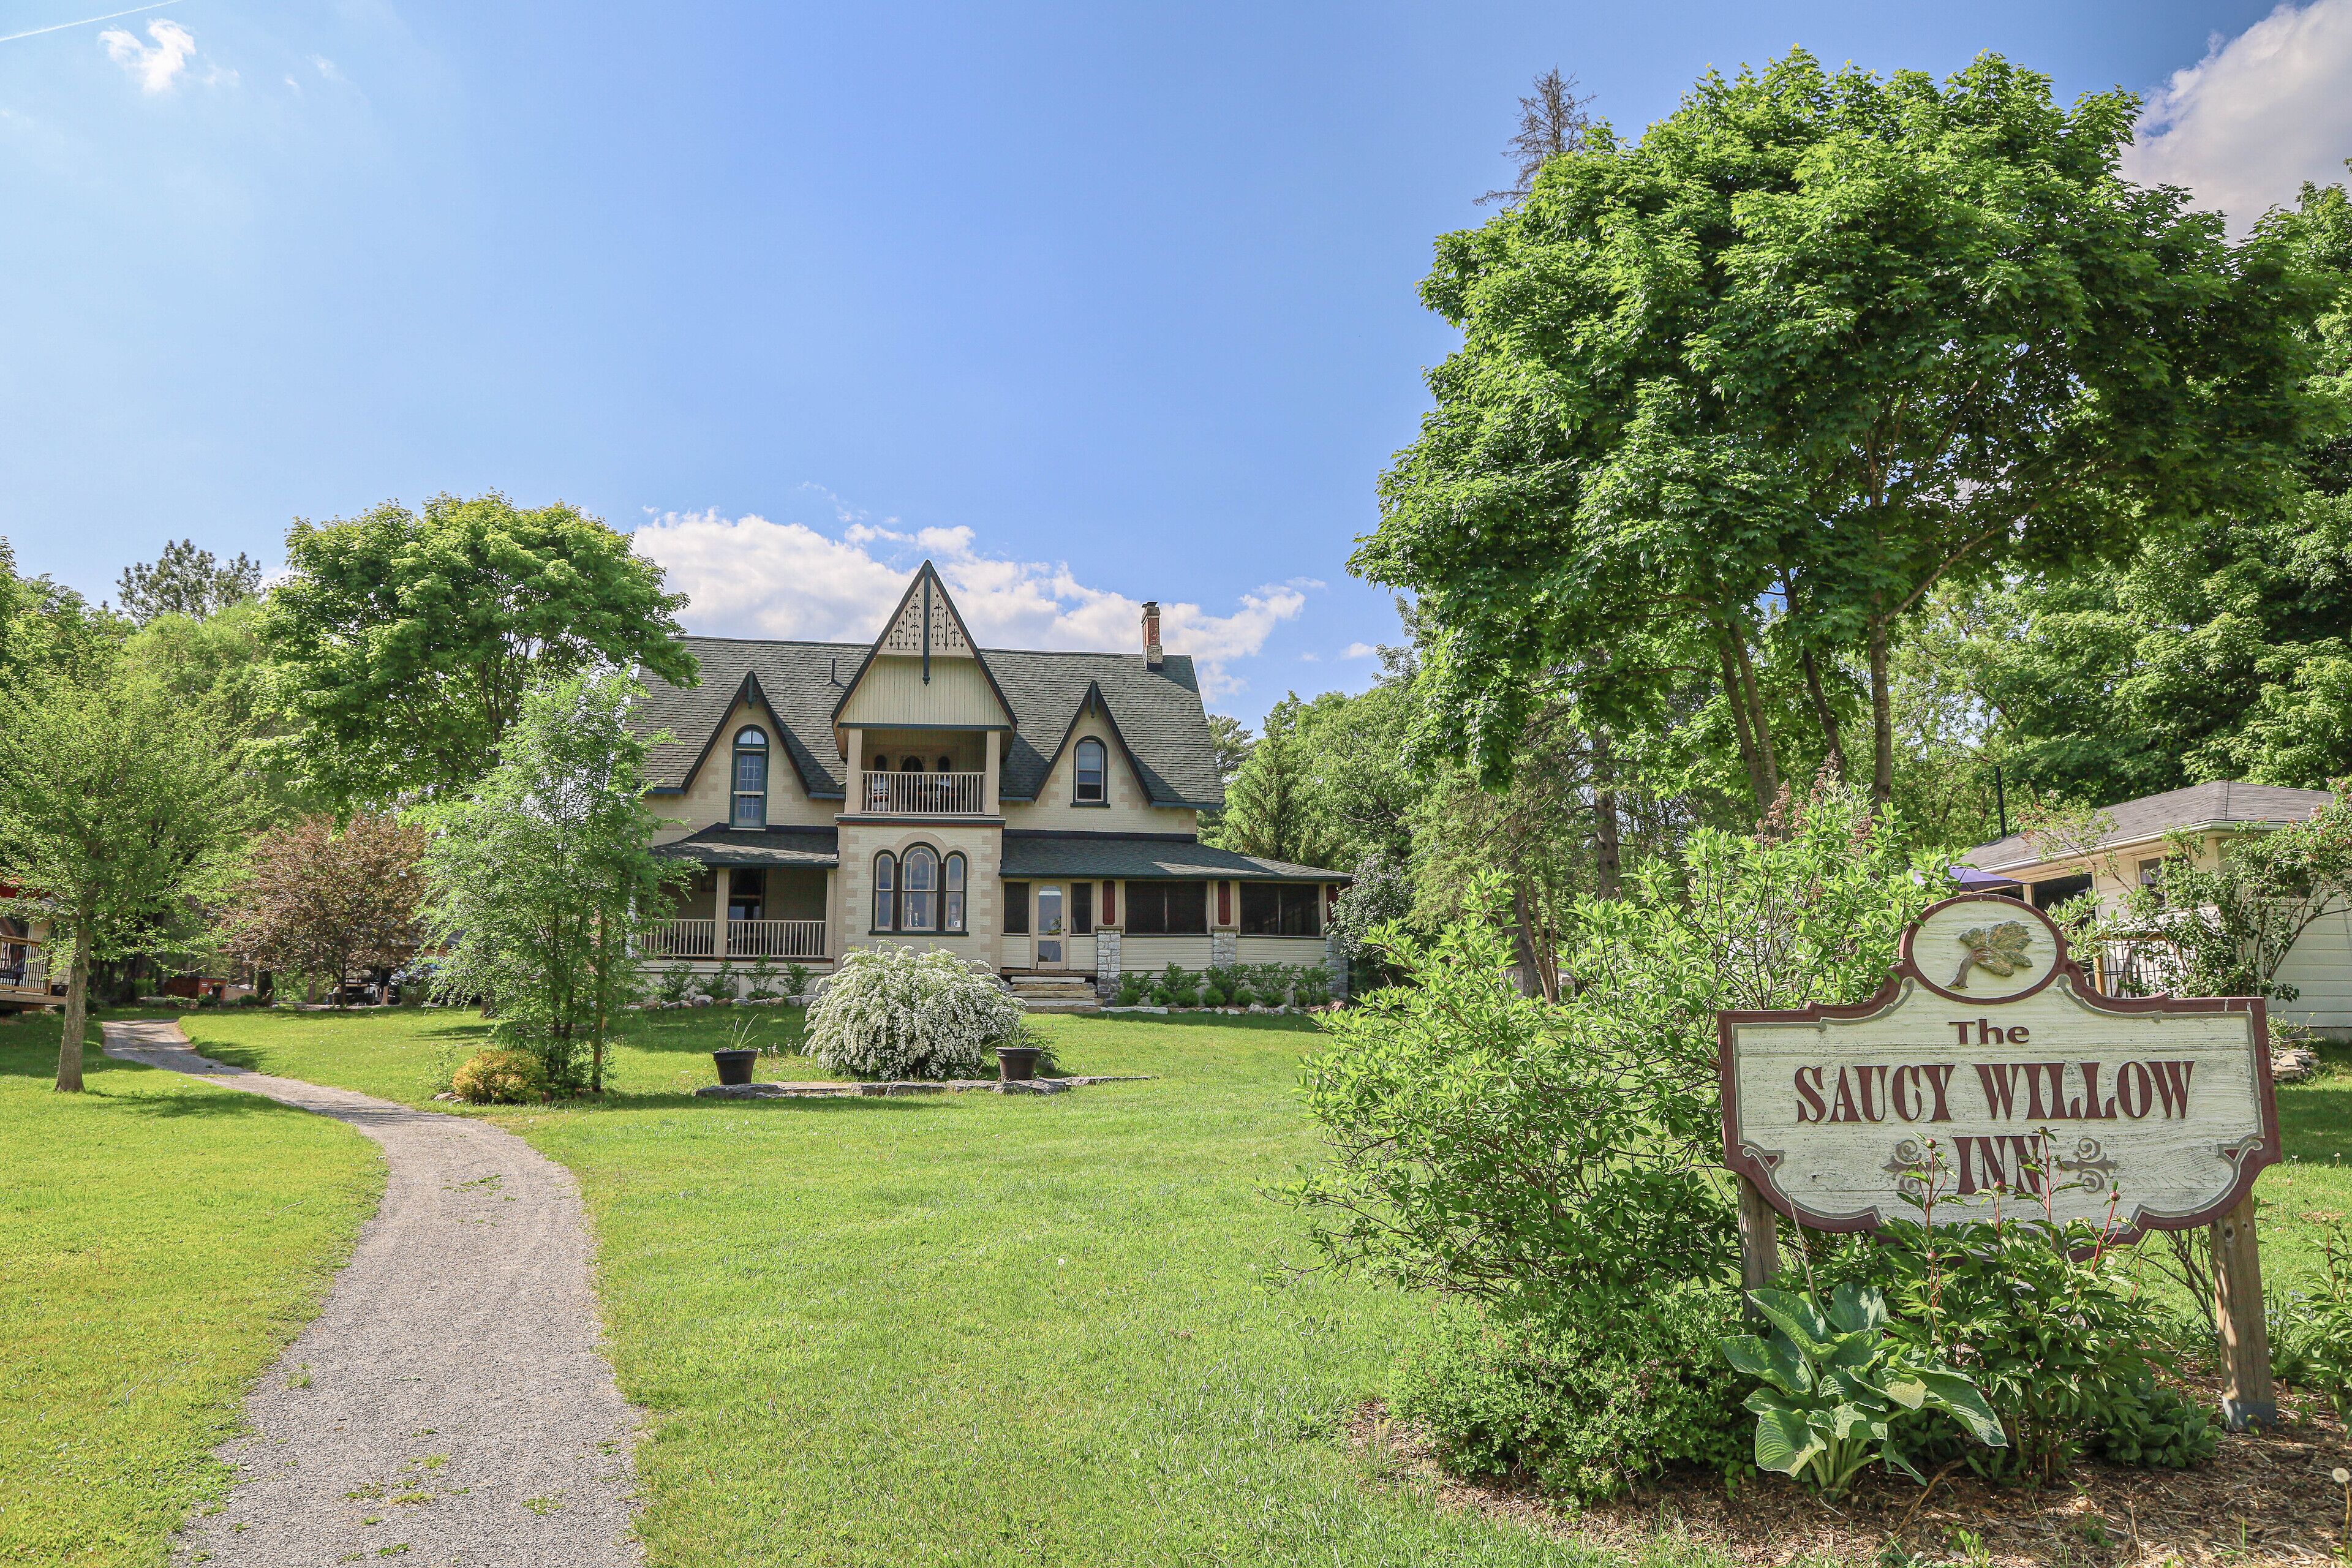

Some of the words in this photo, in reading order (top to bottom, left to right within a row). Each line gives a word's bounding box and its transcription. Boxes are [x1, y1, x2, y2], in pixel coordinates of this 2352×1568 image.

[1948, 1019, 2030, 1044] The
[1794, 1065, 1956, 1122] SAUCY
[1972, 1061, 2195, 1119] WILLOW
[1952, 1136, 2041, 1194] INN
